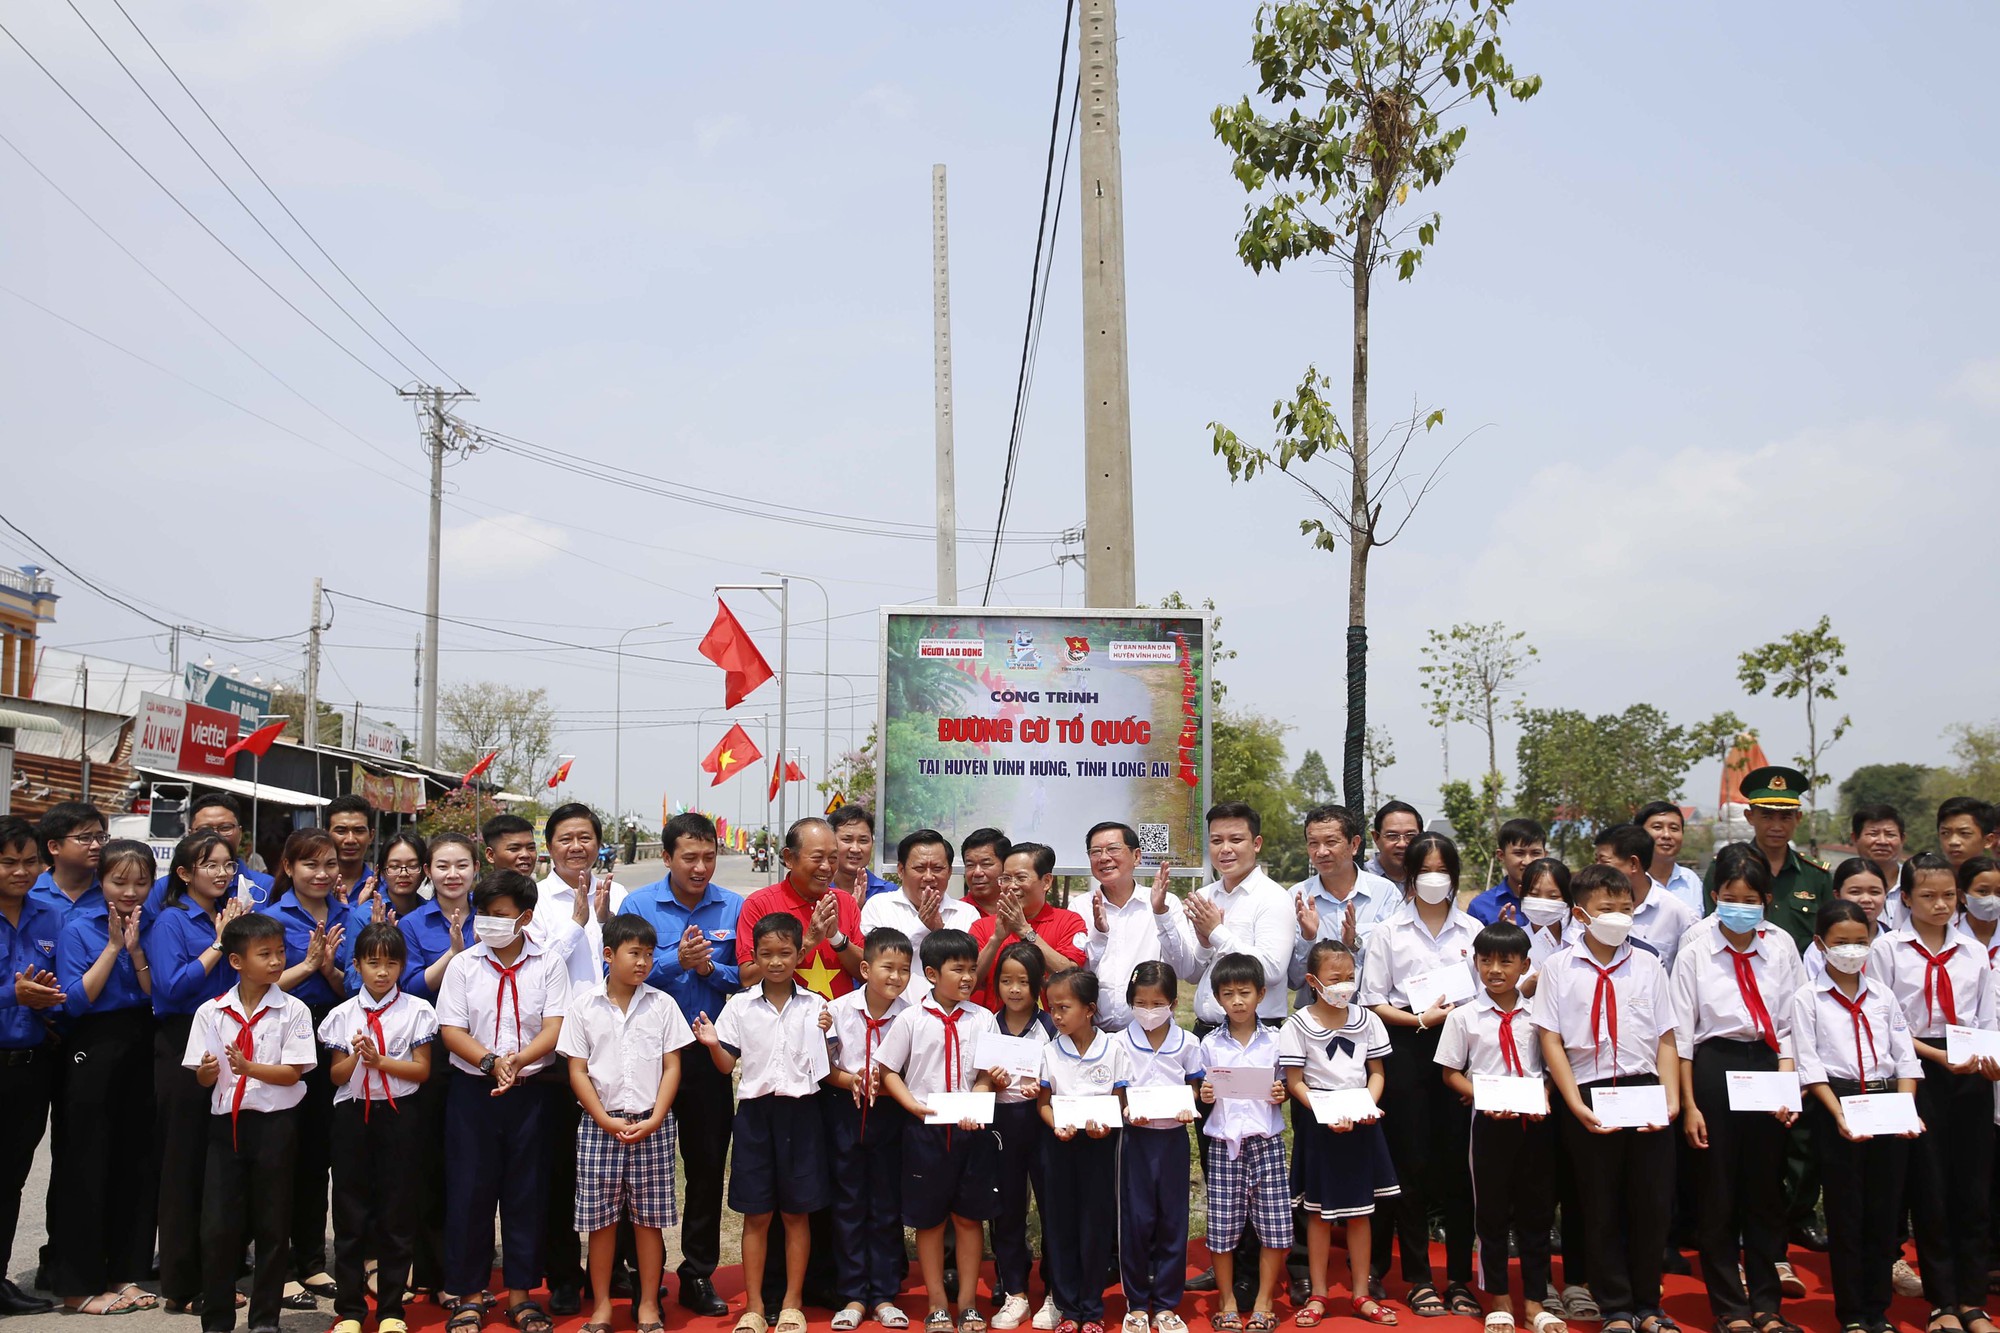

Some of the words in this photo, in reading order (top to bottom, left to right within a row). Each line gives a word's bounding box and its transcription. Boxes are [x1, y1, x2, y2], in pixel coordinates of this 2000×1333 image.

[946, 648, 960, 656] LAO
[990, 689, 1040, 703] CÔNG
[1046, 690, 1099, 703] TRÌNH
[192, 720, 228, 748] viettel
[937, 715, 1013, 742] ĐƯỜNG
[1020, 716, 1050, 743] CỜ
[1056, 712, 1084, 744] TỔ
[1091, 715, 1151, 746] QUỐC
[918, 760, 940, 778] TẠI
[944, 758, 988, 778] HUYỆN
[993, 758, 1025, 776] VĨNH
[1030, 760, 1070, 778] HƯNG,
[1076, 758, 1107, 776] TỈNH
[1112, 762, 1146, 777] LONG
[1152, 762, 1169, 777] AN
